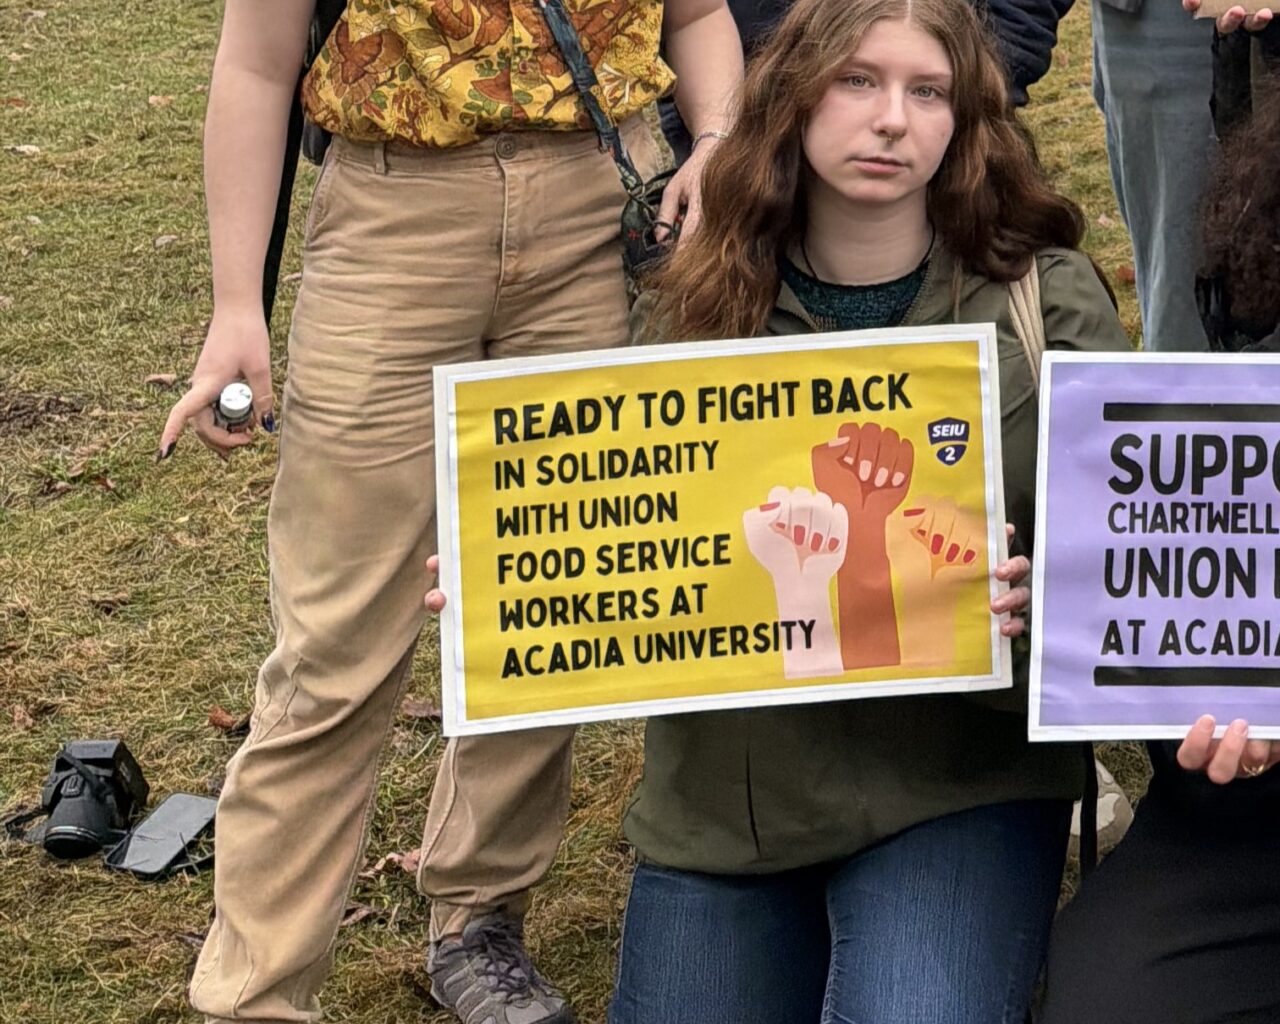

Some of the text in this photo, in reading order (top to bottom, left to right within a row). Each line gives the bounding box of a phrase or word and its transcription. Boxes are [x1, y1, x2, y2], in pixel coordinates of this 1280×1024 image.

[493, 372, 914, 446] READY TO FIGHT BACK
[932, 423, 966, 438] SEIU
[494, 439, 720, 491] IN SOLIDARITY
[944, 446, 956, 462] 2
[496, 491, 679, 538] WITH UNION
[497, 532, 732, 585] FOOD SERVICE
[1103, 547, 1257, 599] UNION
[498, 583, 709, 632] WORKERS AT
[500, 619, 817, 678] ACADIA UNIVERSITY
[1100, 619, 1146, 657] AT
